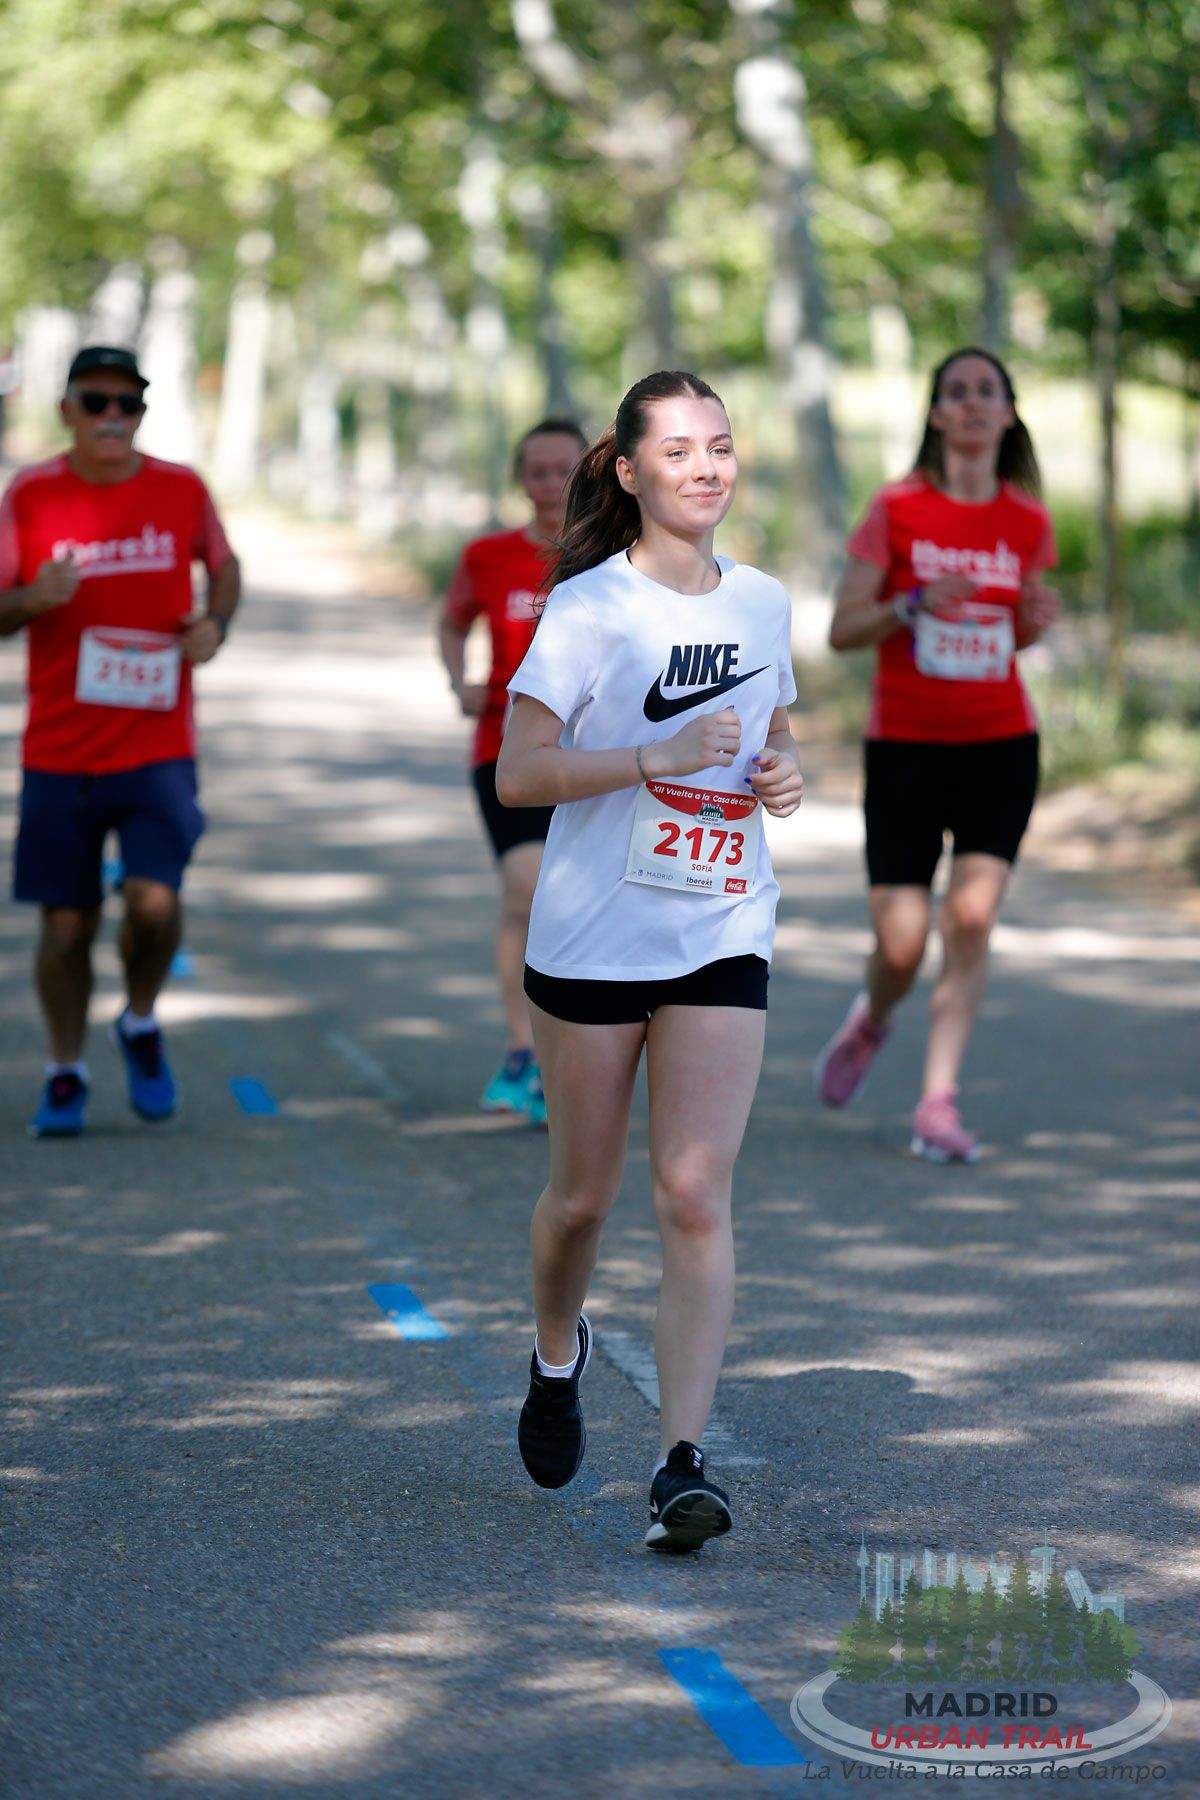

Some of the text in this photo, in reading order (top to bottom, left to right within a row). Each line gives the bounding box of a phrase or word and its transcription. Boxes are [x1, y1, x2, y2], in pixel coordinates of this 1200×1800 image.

[663, 643, 739, 687] NIKE
[653, 785, 664, 793] XII
[666, 788, 693, 798] Vuelta
[702, 793, 710, 801] la
[712, 795, 730, 804] Casa
[730, 797, 739, 805] de
[653, 821, 745, 866] 2173
[647, 871, 674, 881] MADRID
